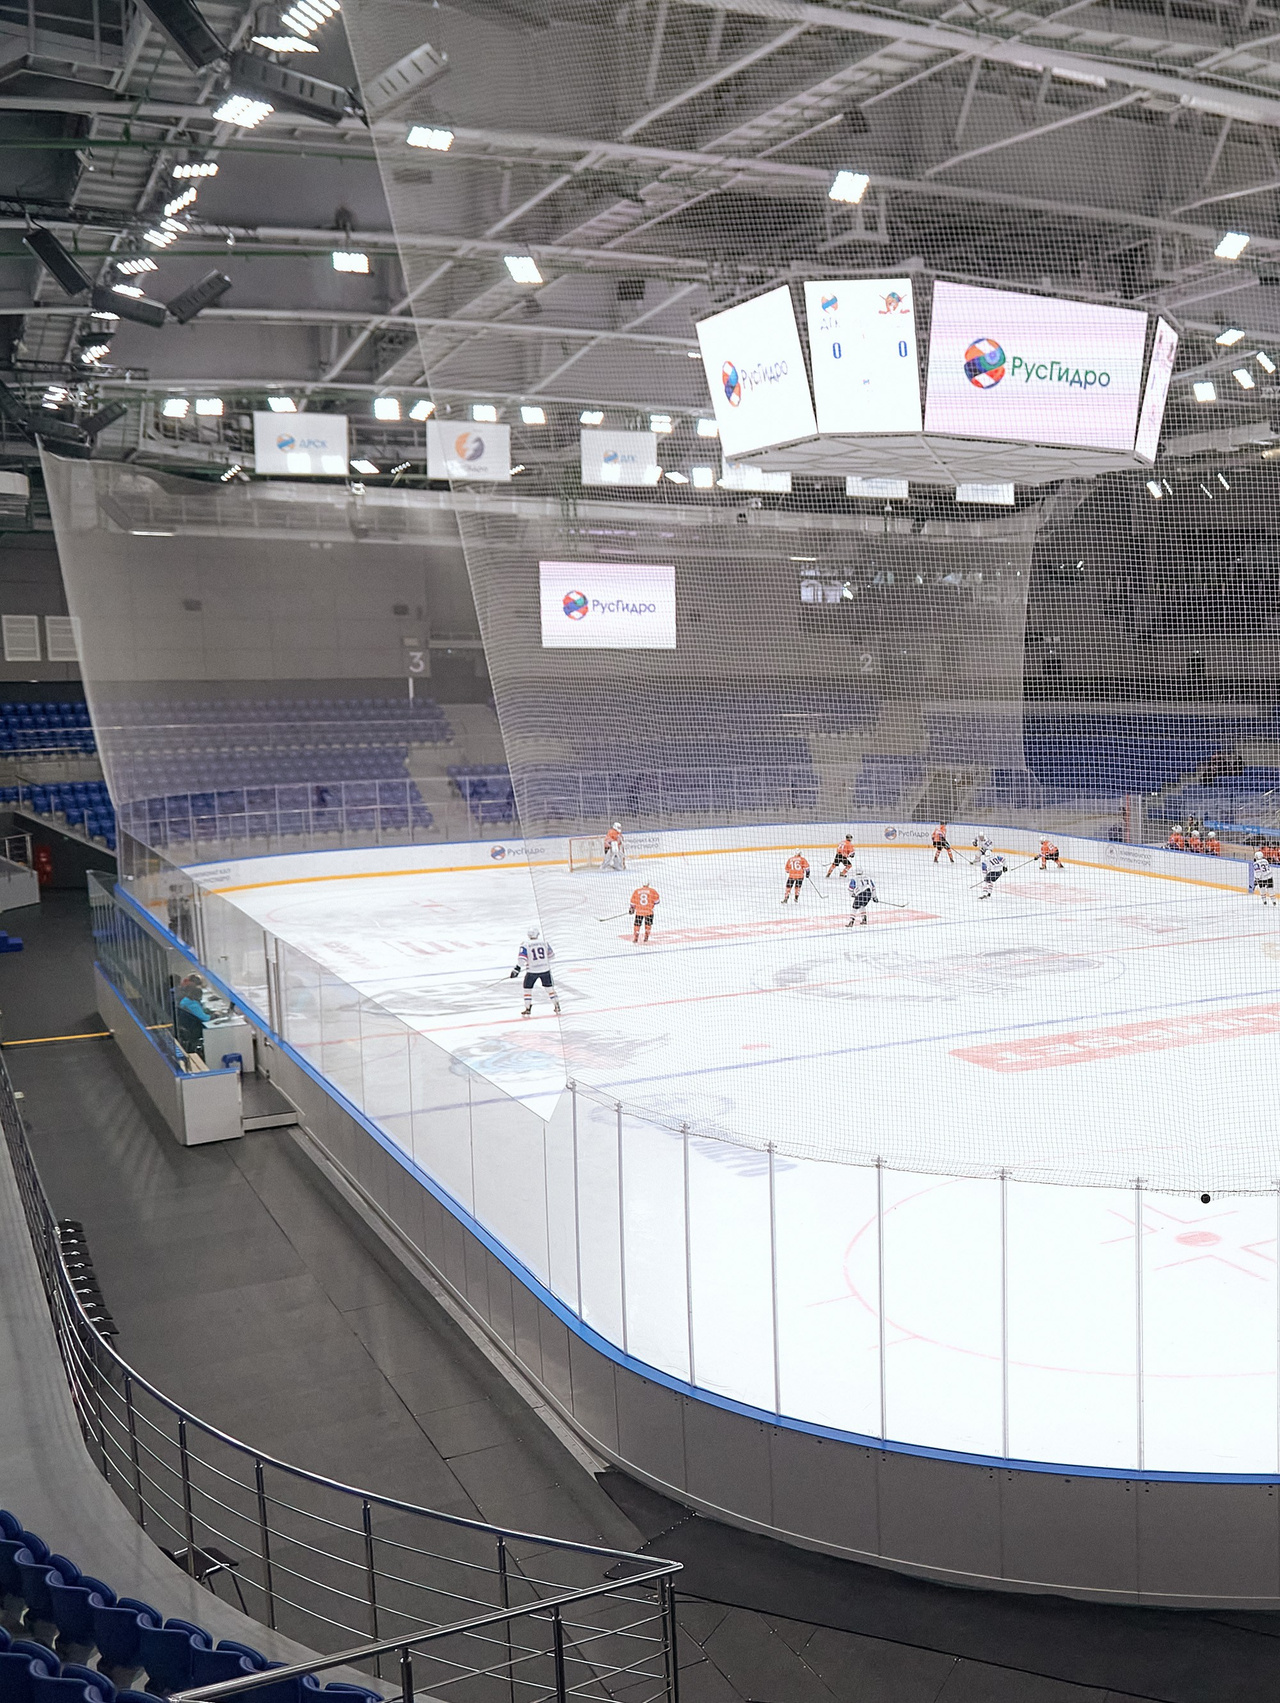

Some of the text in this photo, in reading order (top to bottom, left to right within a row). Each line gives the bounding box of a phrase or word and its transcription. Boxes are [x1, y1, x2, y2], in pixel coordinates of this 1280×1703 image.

[832, 342, 842, 359] 0
[898, 340, 908, 357] 0
[741, 360, 788, 392] РусГидро
[1011, 356, 1111, 390] РусГидро
[592, 599, 656, 616] РусГидро
[409, 651, 424, 673] 3
[860, 653, 873, 671] 2
[899, 830, 930, 838] РусГидро
[790, 860, 802, 871] 16
[639, 893, 649, 906] 8
[531, 947, 545, 961] 19
